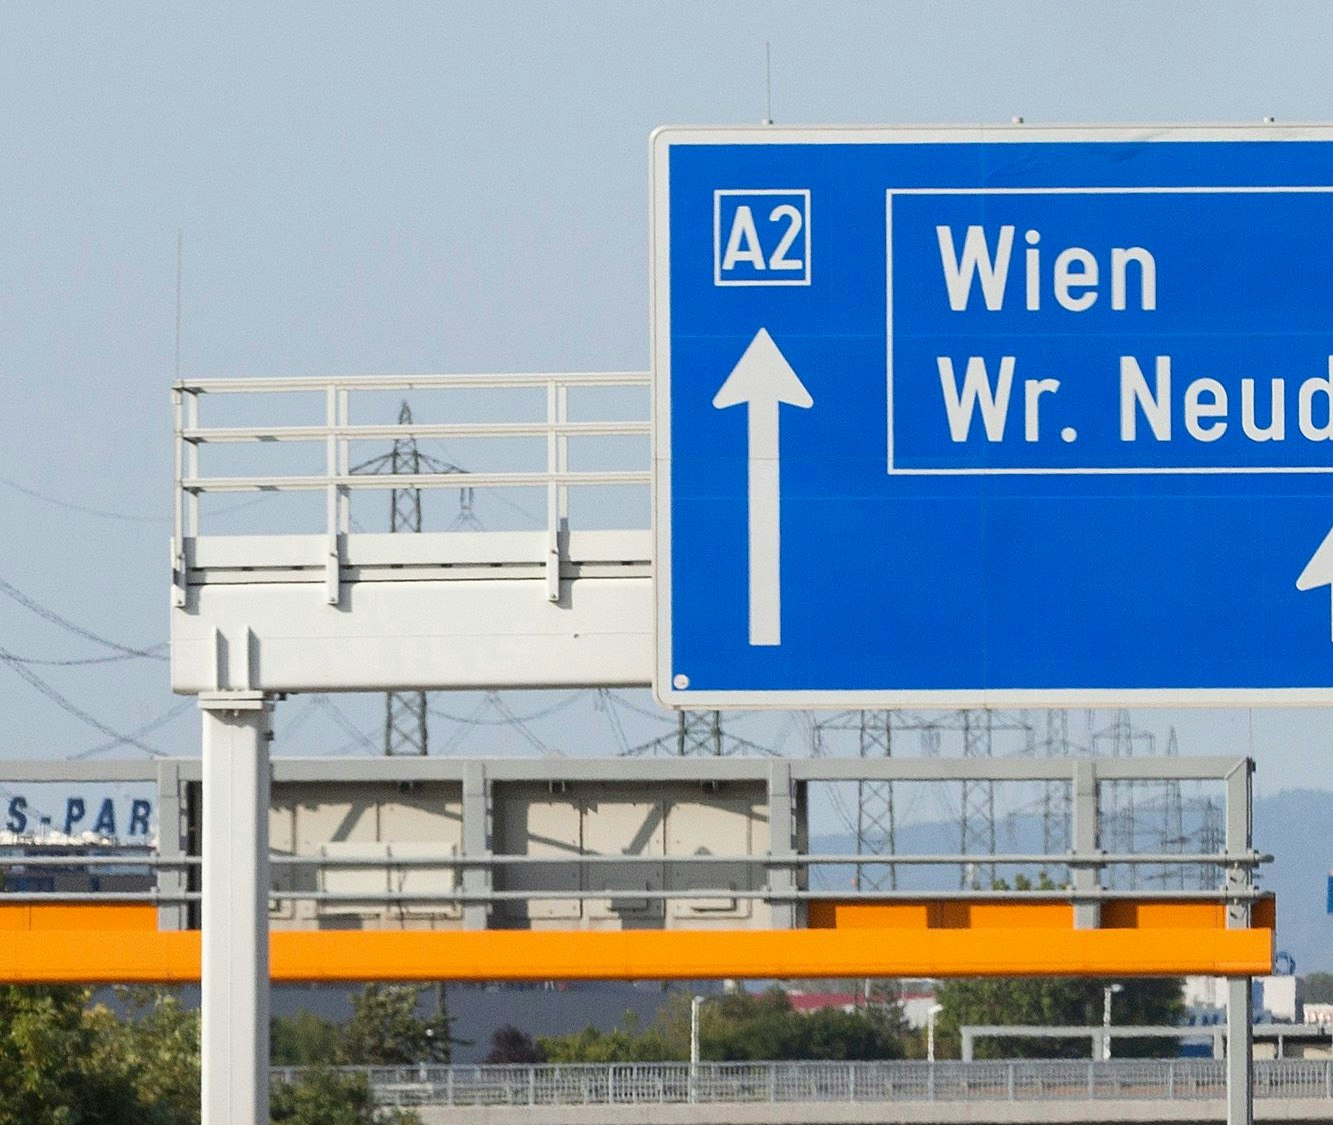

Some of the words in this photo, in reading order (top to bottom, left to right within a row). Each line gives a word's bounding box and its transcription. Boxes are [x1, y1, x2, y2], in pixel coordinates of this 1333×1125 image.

[723, 204, 803, 270] A2
[936, 225, 1156, 312] Wien
[937, 356, 1077, 443] Wr.
